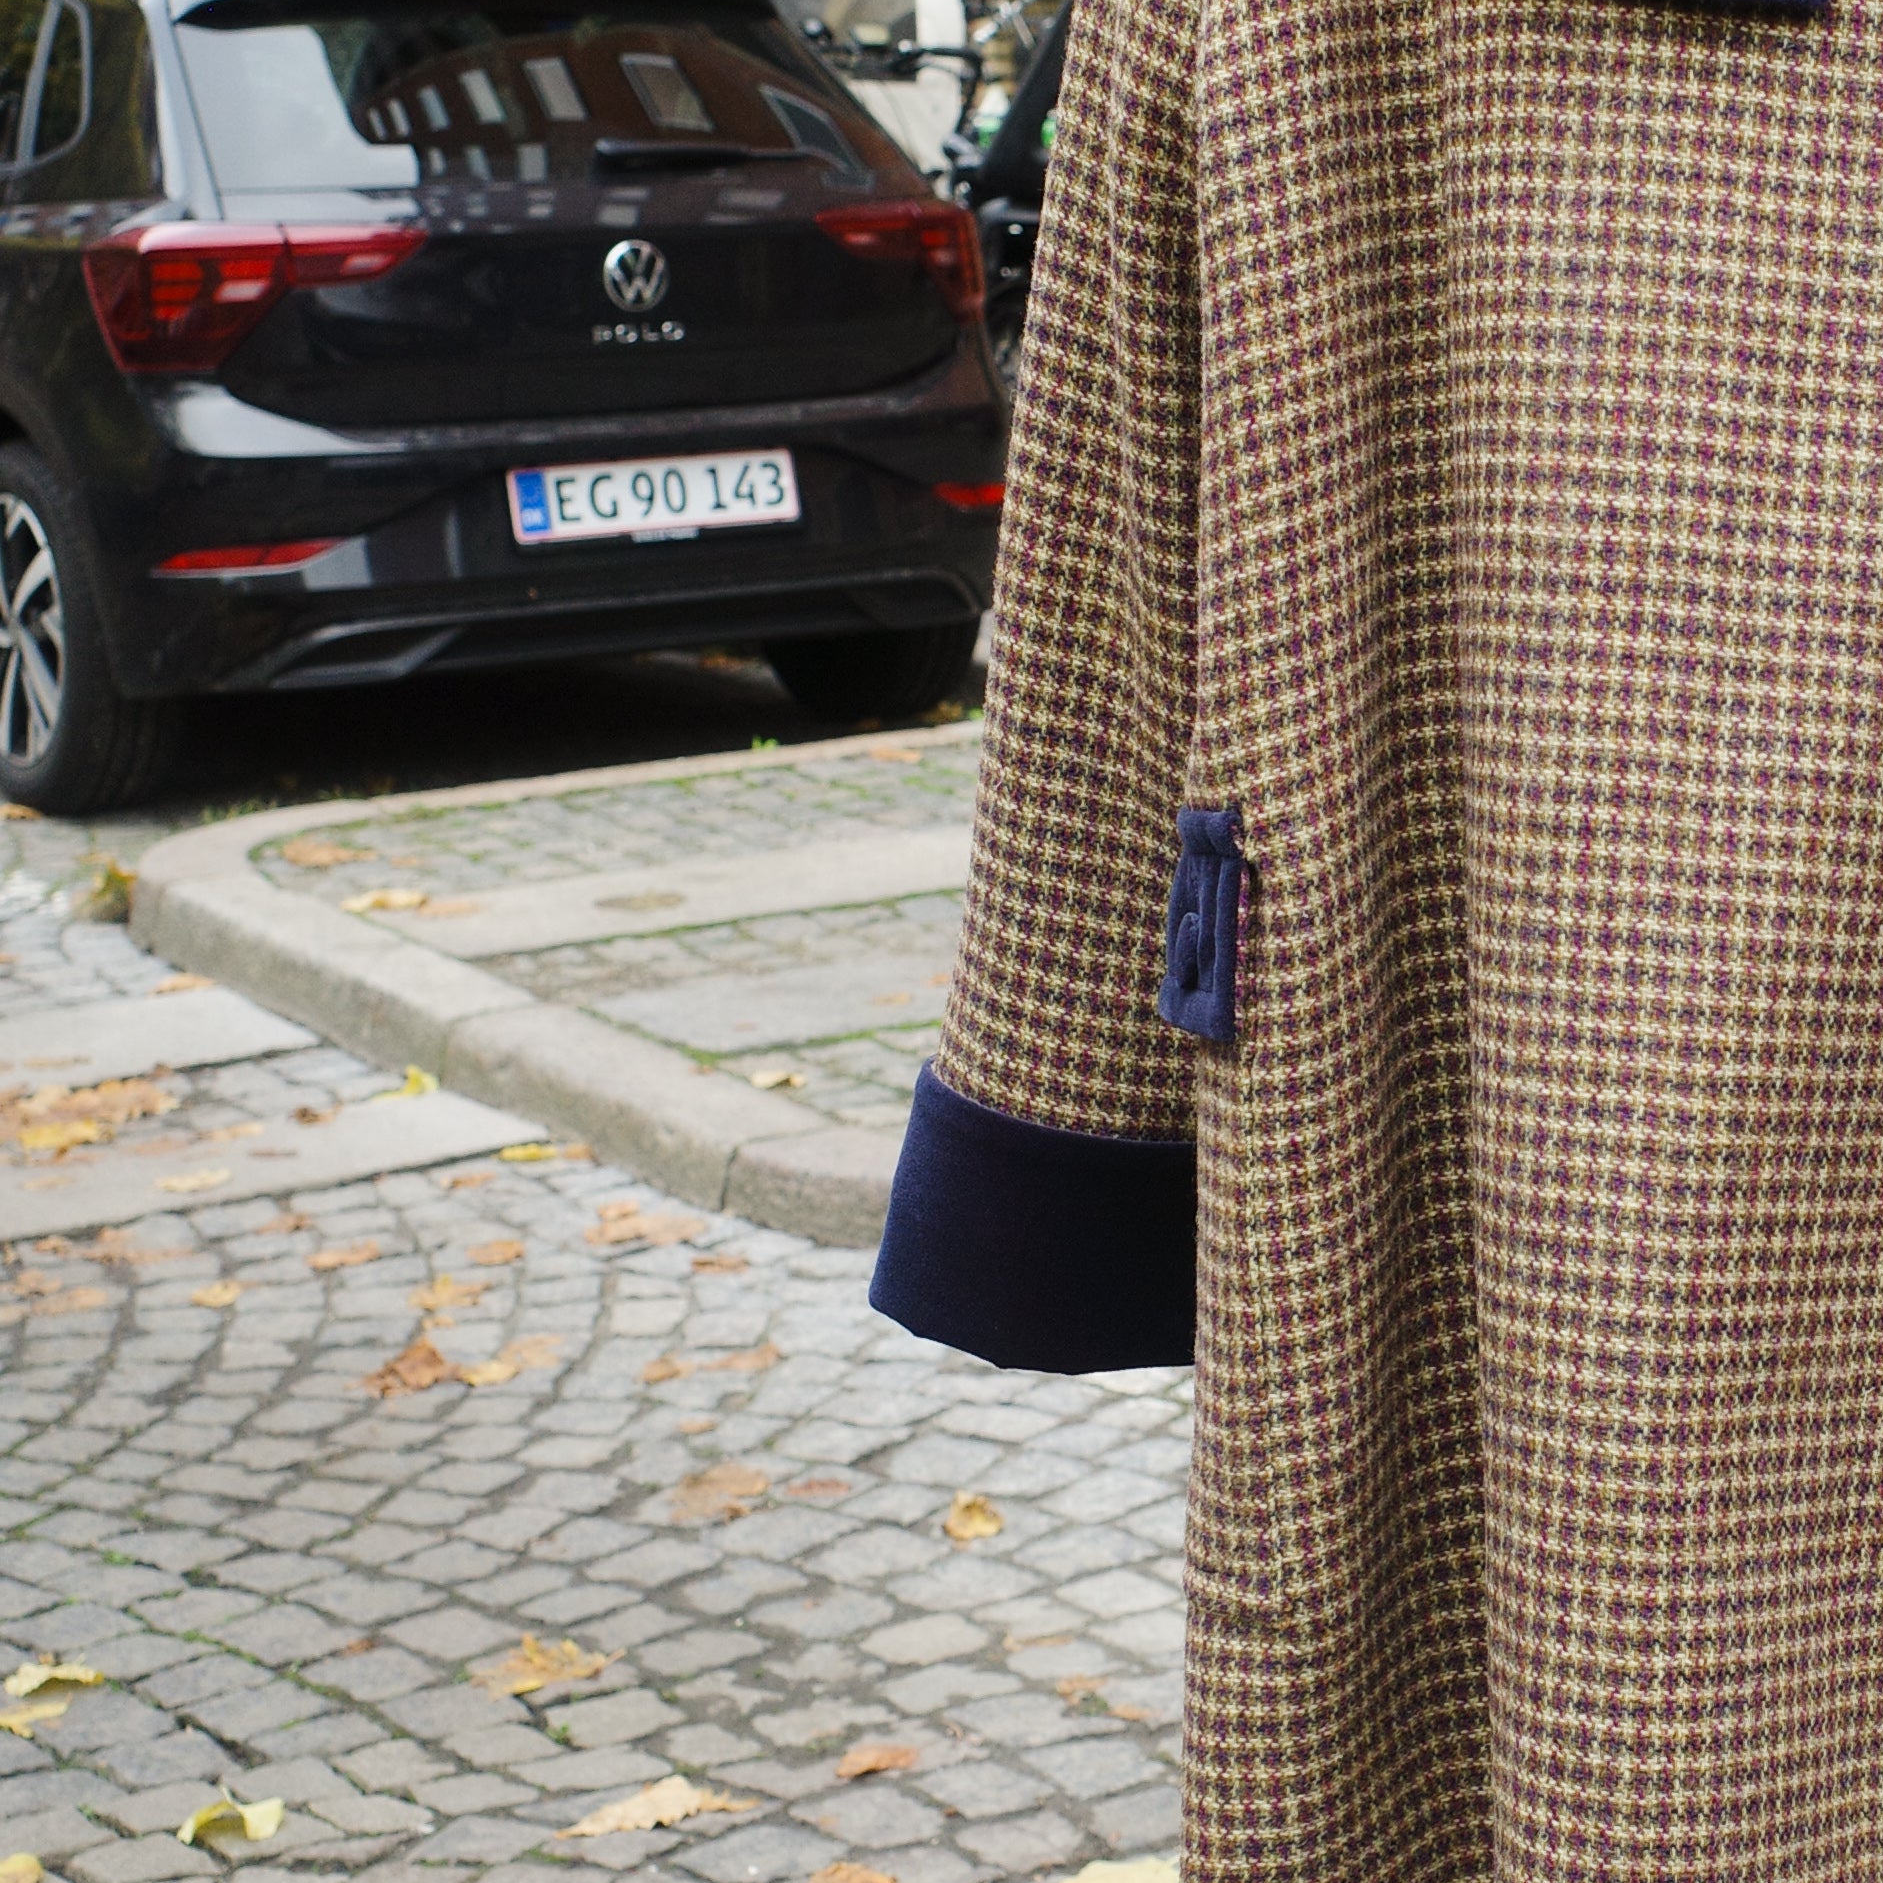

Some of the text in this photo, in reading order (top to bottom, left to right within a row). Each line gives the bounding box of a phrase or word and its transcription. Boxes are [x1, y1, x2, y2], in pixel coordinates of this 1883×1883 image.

[592, 321, 685, 345] POLO
[555, 462, 785, 522] EG 90 143
